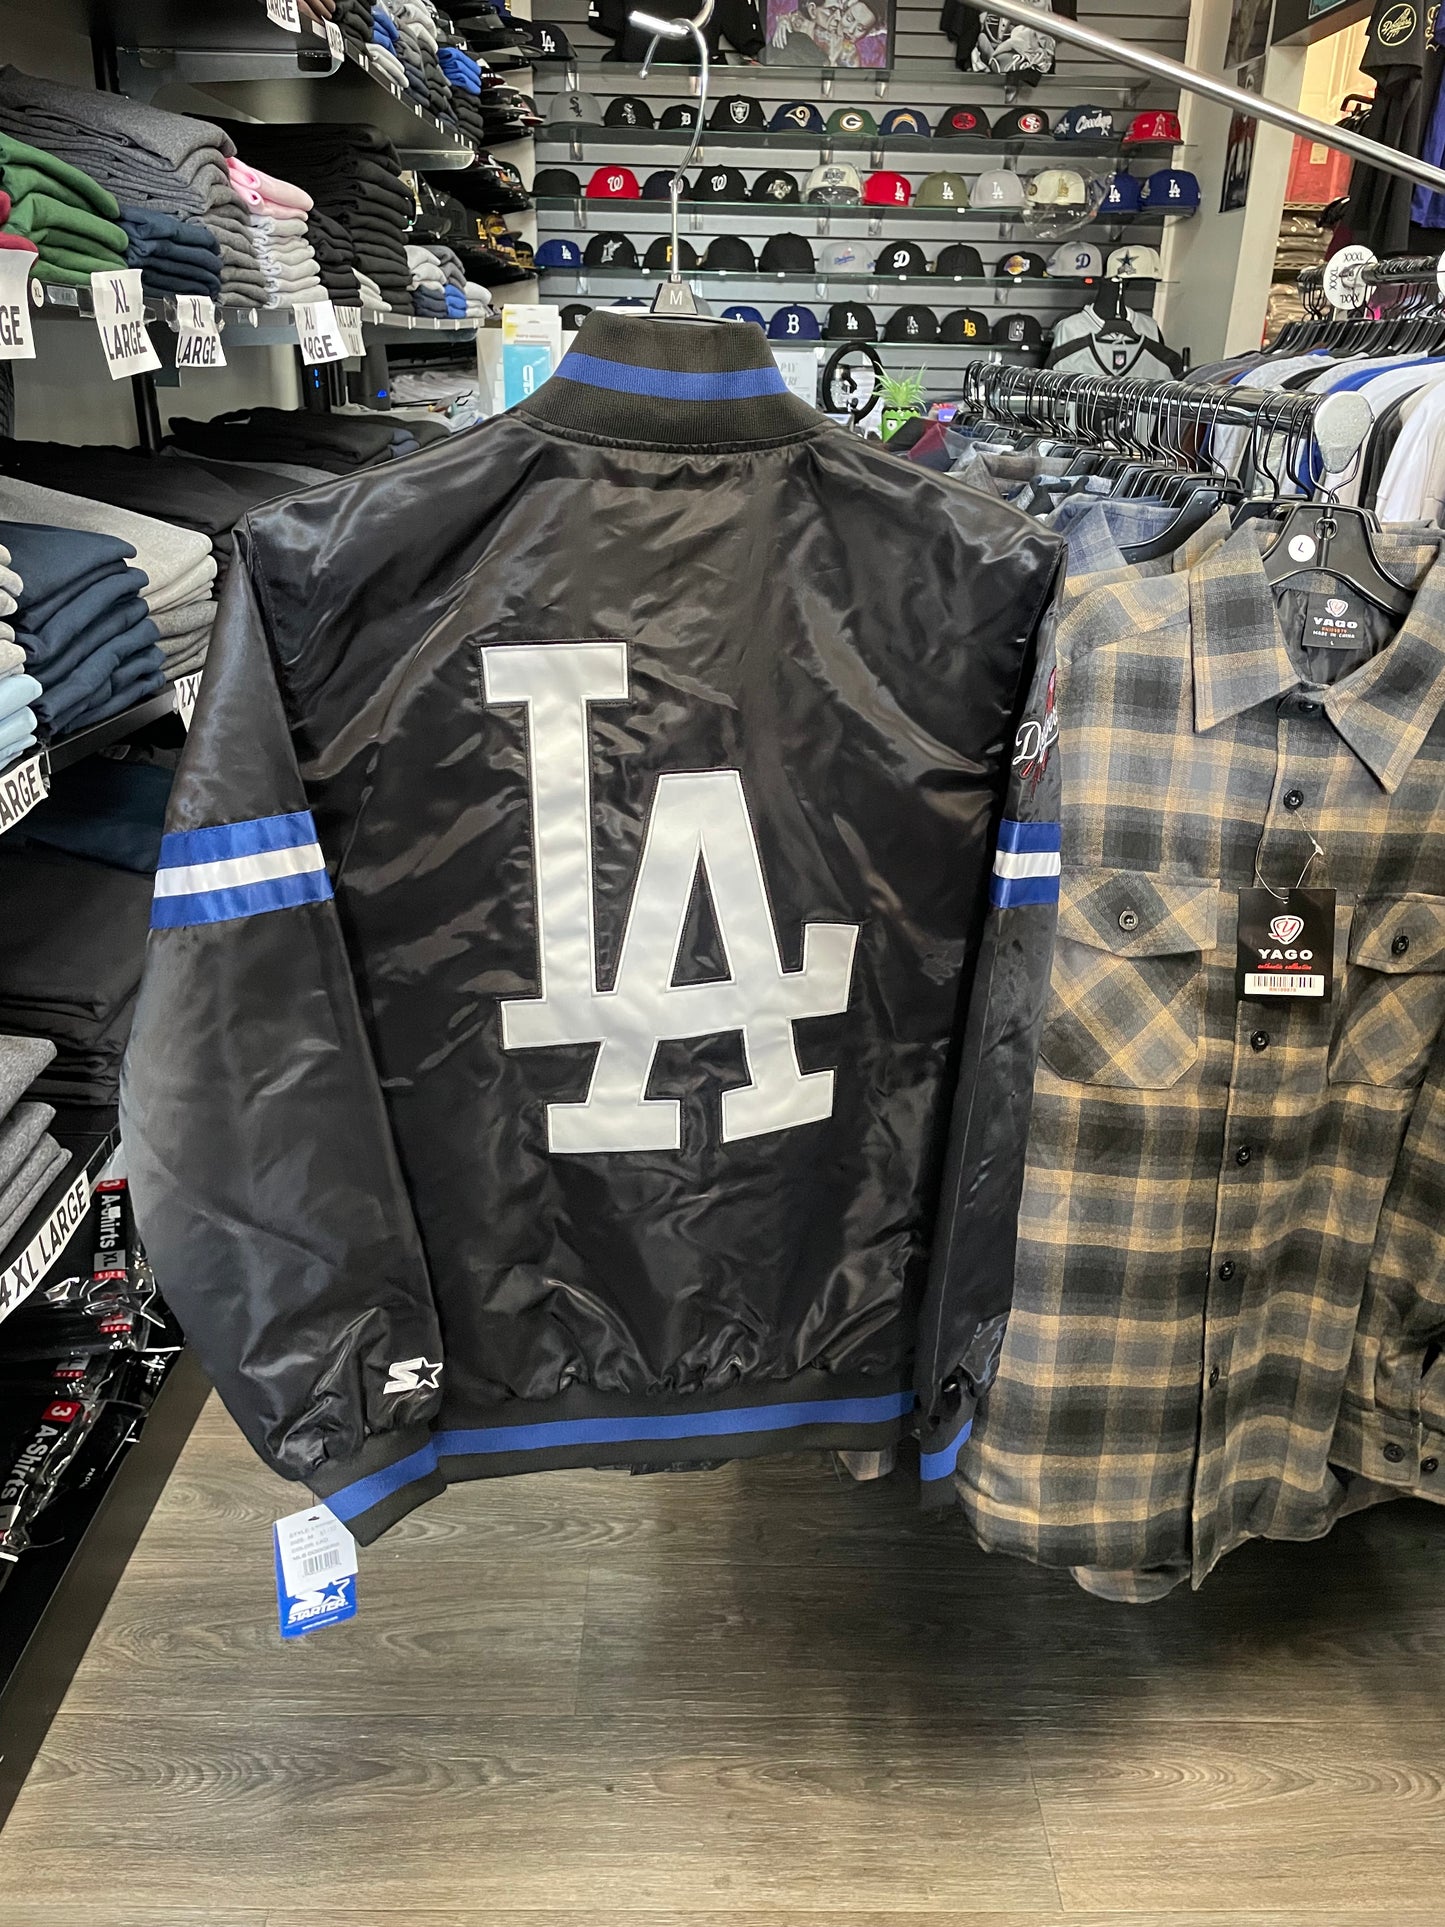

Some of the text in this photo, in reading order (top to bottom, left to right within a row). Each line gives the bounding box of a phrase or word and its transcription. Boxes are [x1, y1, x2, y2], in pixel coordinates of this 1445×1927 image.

[540, 30, 556, 53] LA
[894, 181, 905, 201] LA
[942, 181, 954, 200] LA
[991, 181, 1004, 200] LA
[1108, 184, 1121, 203] LA
[1168, 178, 1181, 198] LA
[561, 245, 573, 260] LA
[893, 249, 911, 268] D
[1075, 253, 1091, 270] D
[1344, 252, 1364, 261] XXXL
[110, 279, 130, 314] XL
[670, 290, 683, 305] M
[190, 298, 205, 328] XL
[303, 306, 315, 331] XL
[846, 312, 859, 330] LA
[786, 313, 800, 334] B
[103, 320, 148, 360] LARGE
[177, 336, 217, 364] LARGE
[1297, 542, 1305, 553] L
[480, 641, 860, 1153] LA
[1258, 948, 1314, 961] YAGO
[38, 1179, 87, 1266] LARGE
[103, 1252, 118, 1268] XL
[51, 1405, 73, 1417] 3
[1, 1424, 59, 1500] A-Shirts
